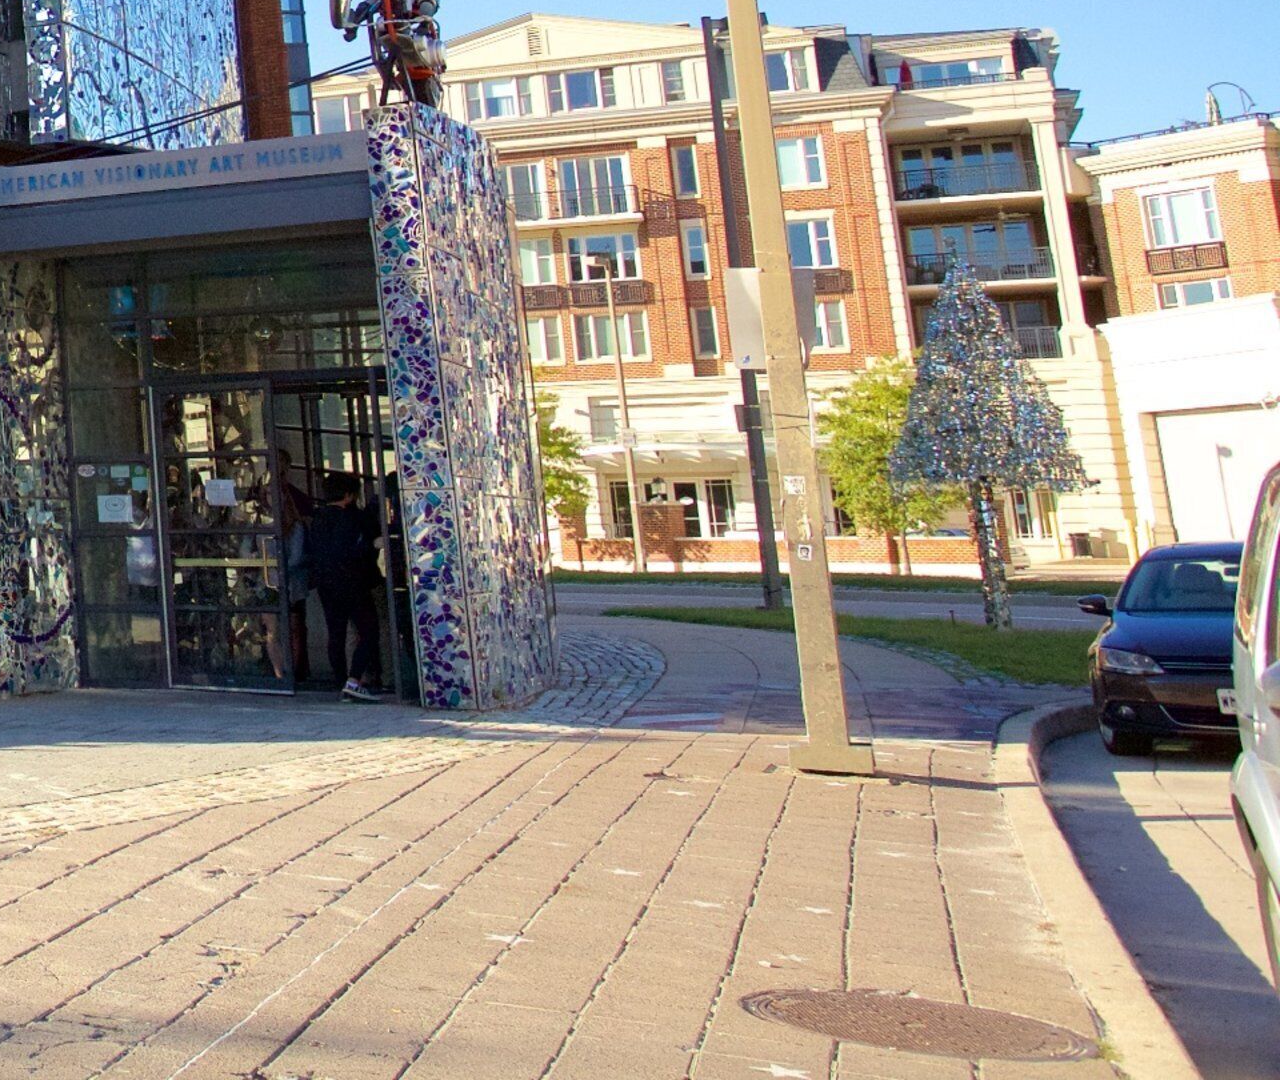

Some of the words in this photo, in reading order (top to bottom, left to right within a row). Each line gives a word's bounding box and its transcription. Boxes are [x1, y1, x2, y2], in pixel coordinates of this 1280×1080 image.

[95, 158, 198, 184] VISIONARY
[209, 153, 244, 173] ART
[256, 143, 343, 167] MUSEUM
